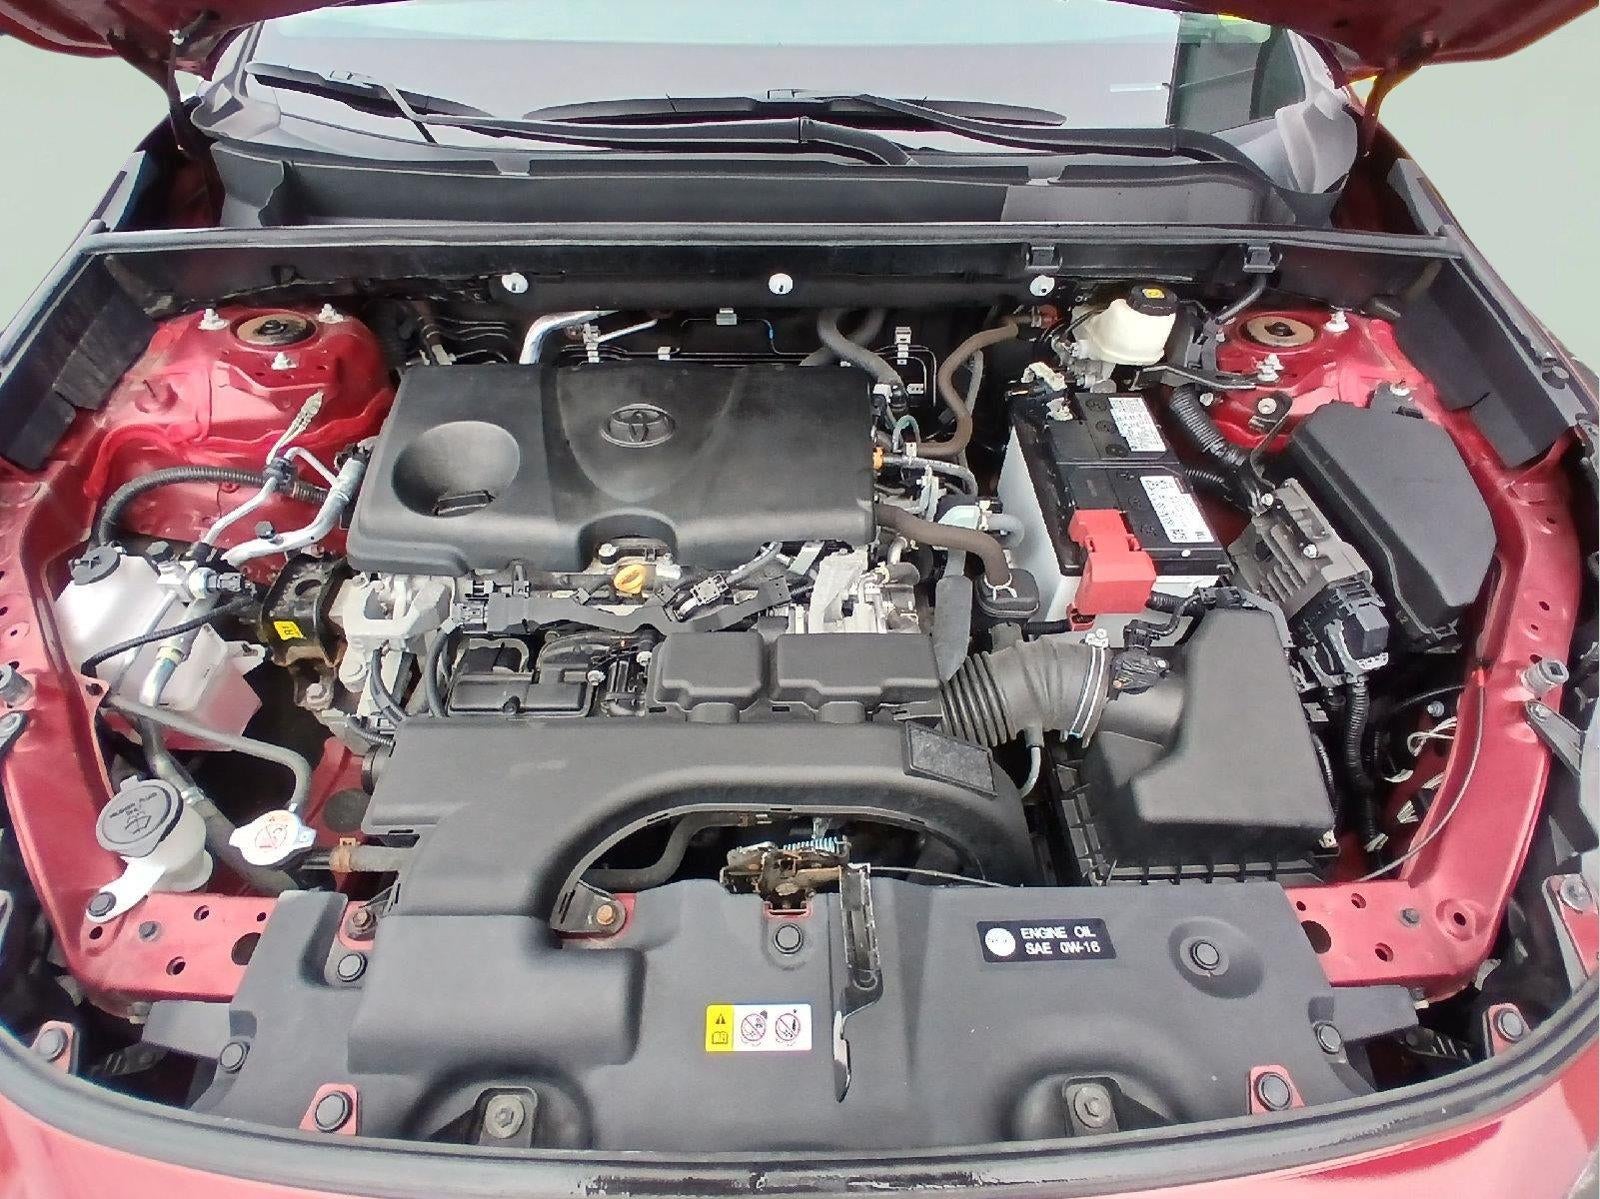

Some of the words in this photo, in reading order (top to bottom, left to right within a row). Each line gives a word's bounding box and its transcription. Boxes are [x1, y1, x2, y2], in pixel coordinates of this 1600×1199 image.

[1020, 926, 1067, 939] ENGINE
[1073, 925, 1096, 937] OIL
[1025, 942, 1052, 954] SAE
[1059, 941, 1100, 953] 0W-16
